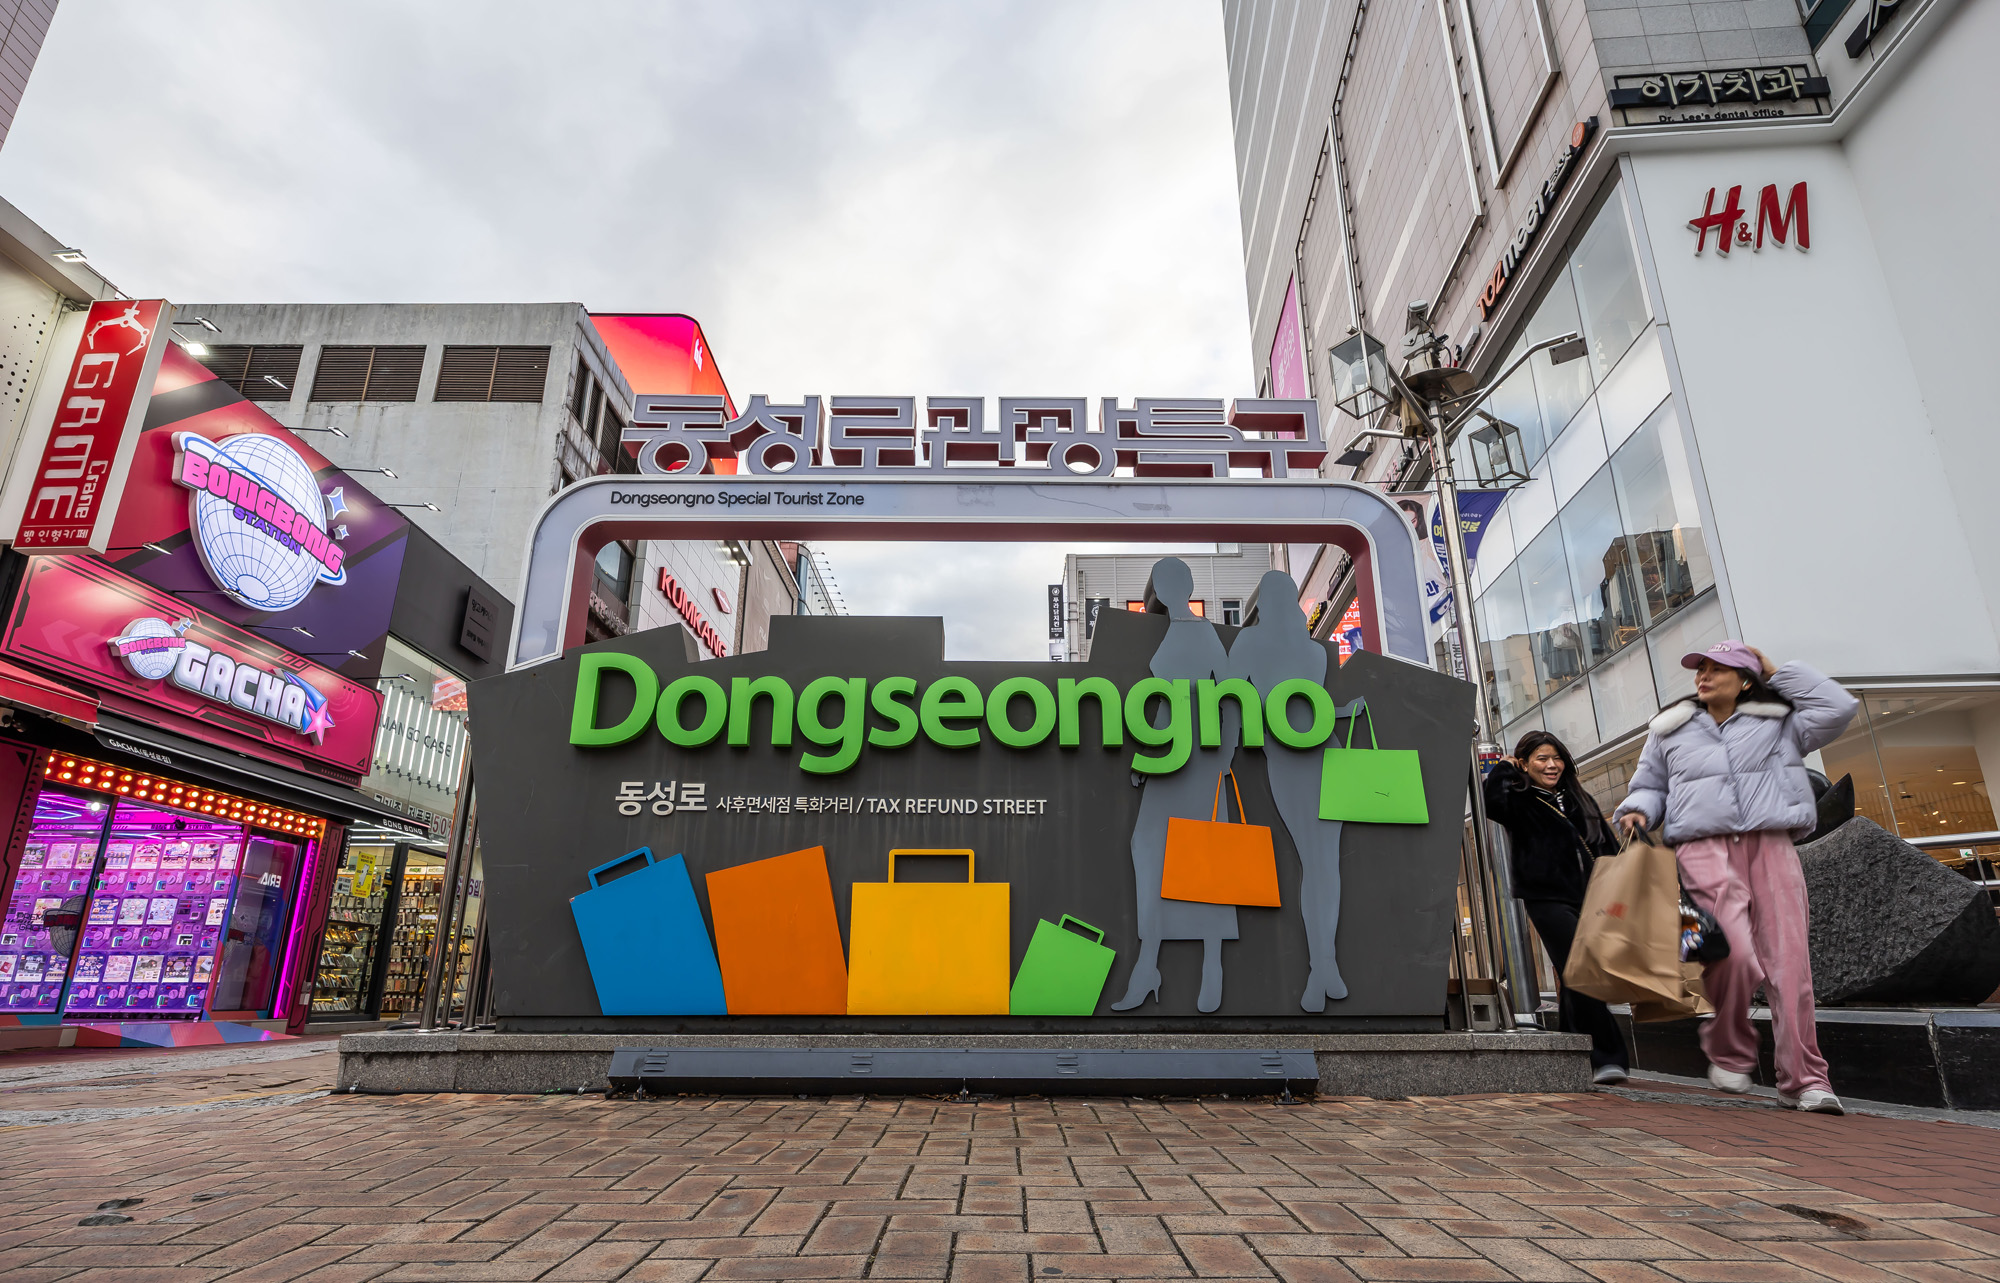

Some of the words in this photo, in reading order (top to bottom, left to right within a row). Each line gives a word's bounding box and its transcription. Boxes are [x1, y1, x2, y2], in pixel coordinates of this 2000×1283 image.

[1642, 66, 1805, 107] 이가치과
[1659, 114, 1675, 123] Dr.
[1682, 112, 1711, 121] Lee's
[1714, 110, 1749, 120] dental
[1752, 108, 1785, 117] office
[1687, 181, 1811, 256] H&M
[30, 352, 120, 520] GAME
[74, 460, 108, 519] Crane
[182, 448, 346, 575] BONGBONG
[610, 490, 715, 508] Dongseongno
[718, 490, 771, 508] Special
[774, 491, 823, 506] Tourist
[826, 491, 865, 506] Zone
[233, 506, 301, 556] STATION
[659, 566, 727, 658] KUMKANG
[119, 637, 186, 657] BONGBONG
[173, 641, 307, 729] GACHA
[570, 651, 1335, 776] Dongseongno
[424, 735, 452, 758] CASE
[615, 780, 708, 816] 동성로
[716, 796, 791, 815] 사후면세점
[794, 796, 854, 815] 특화거리
[867, 799, 900, 814] TAX
[905, 799, 978, 815] REFUND
[983, 799, 1047, 815] STREET
[382, 819, 403, 831] BONG
[404, 825, 423, 835] BONG
